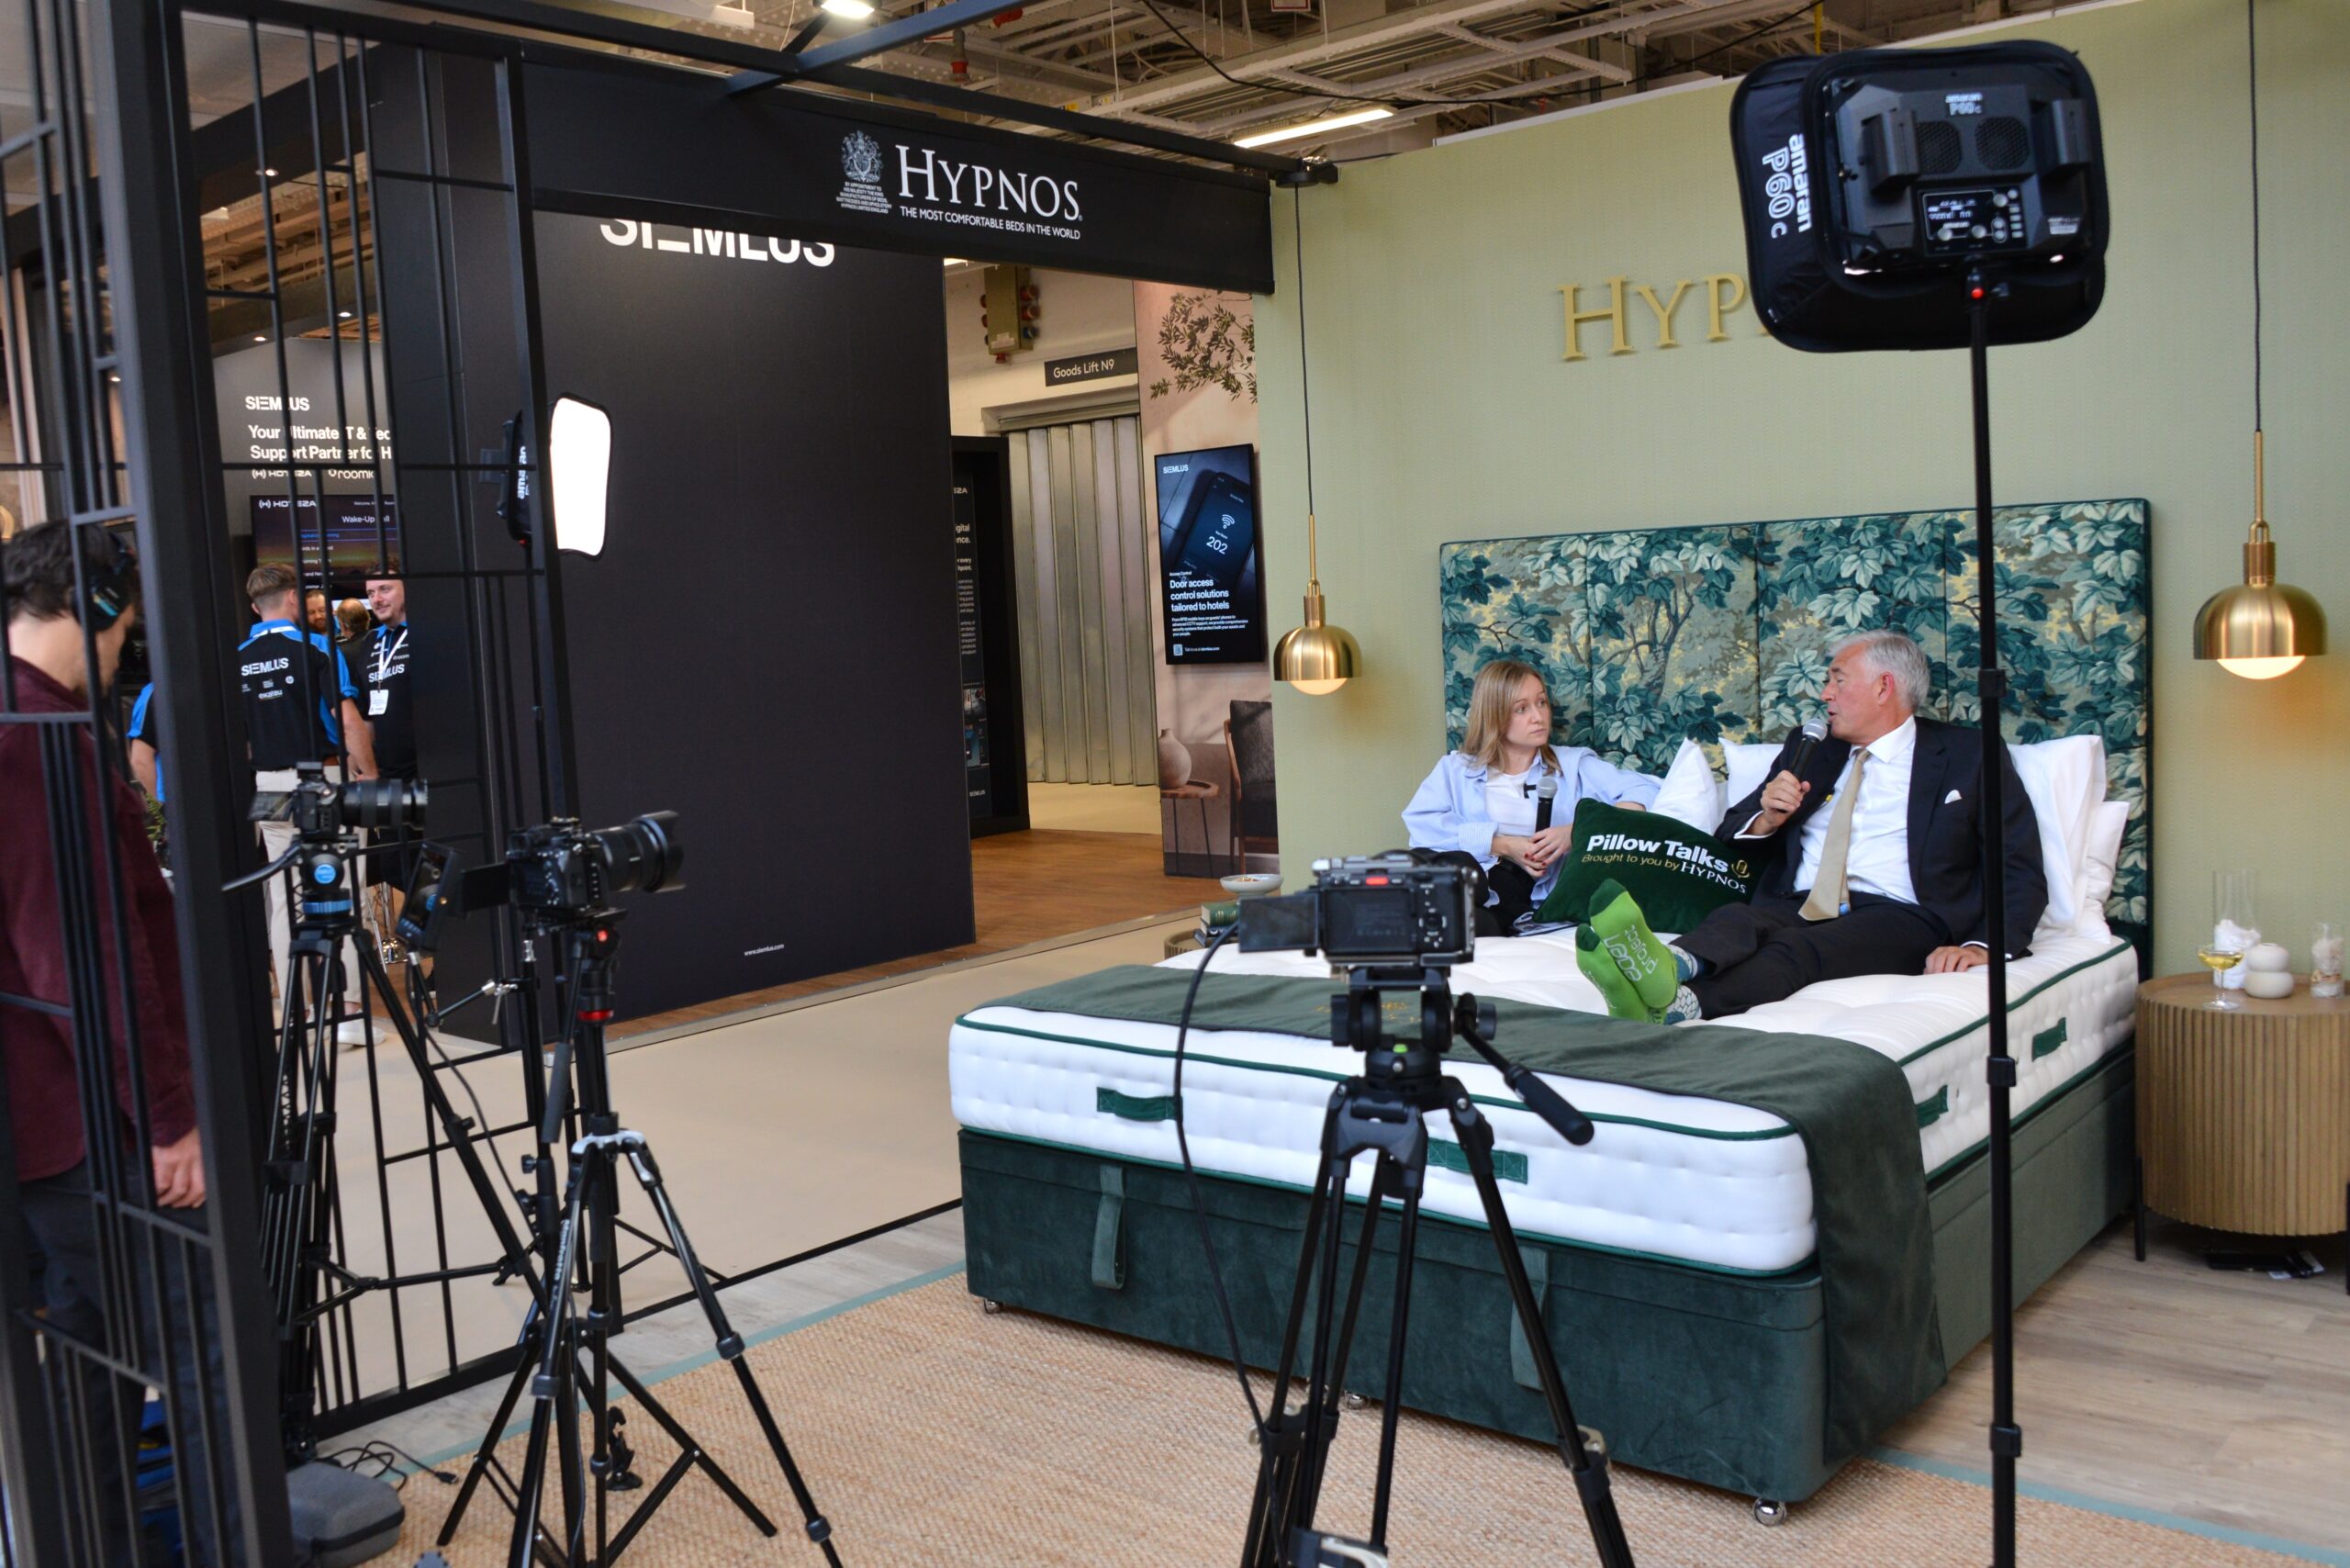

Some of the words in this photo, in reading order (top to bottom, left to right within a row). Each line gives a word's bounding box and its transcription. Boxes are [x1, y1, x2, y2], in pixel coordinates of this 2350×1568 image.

[895, 144, 1081, 221] HYPNOS
[1789, 133, 1813, 233] amaran
[900, 206, 918, 218] THE
[919, 208, 943, 221] MOST
[945, 212, 1004, 230] COMFORTABLE
[1006, 220, 1025, 233] BEDS
[1026, 223, 1035, 234] IN
[1035, 224, 1051, 236] THE
[1052, 227, 1080, 240] WORLD
[1558, 274, 1747, 360] HYP
[1053, 364, 1082, 378] Goods
[1083, 361, 1099, 374] Lift
[1101, 358, 1114, 371] N9
[245, 396, 310, 411] SIEMUS
[248, 425, 281, 439] Your
[290, 426, 339, 440] ltimate
[356, 427, 367, 440] &
[517, 446, 527, 500] amaan
[1163, 464, 1189, 474] SIEMLUS
[342, 516, 375, 524] Wake-Up
[1206, 536, 1228, 555] 202
[1169, 580, 1187, 589] Door
[1188, 579, 1214, 588] access
[1170, 590, 1196, 600] control
[1196, 589, 1230, 599] solutions
[1171, 601, 1198, 612] tailored
[1199, 602, 1207, 610] to
[1207, 600, 1230, 610] hotels
[241, 657, 289, 676] SIEMLUS
[368, 663, 405, 683] SIMLUS
[1586, 834, 1662, 853] Pillow
[1664, 840, 1729, 873] Talks
[1581, 853, 1624, 863] Brought
[1626, 854, 1638, 863] to
[1641, 857, 1662, 867] you
[1664, 858, 1681, 871] by
[1680, 861, 1747, 894] HYPNOS
[1624, 924, 1658, 974] project
